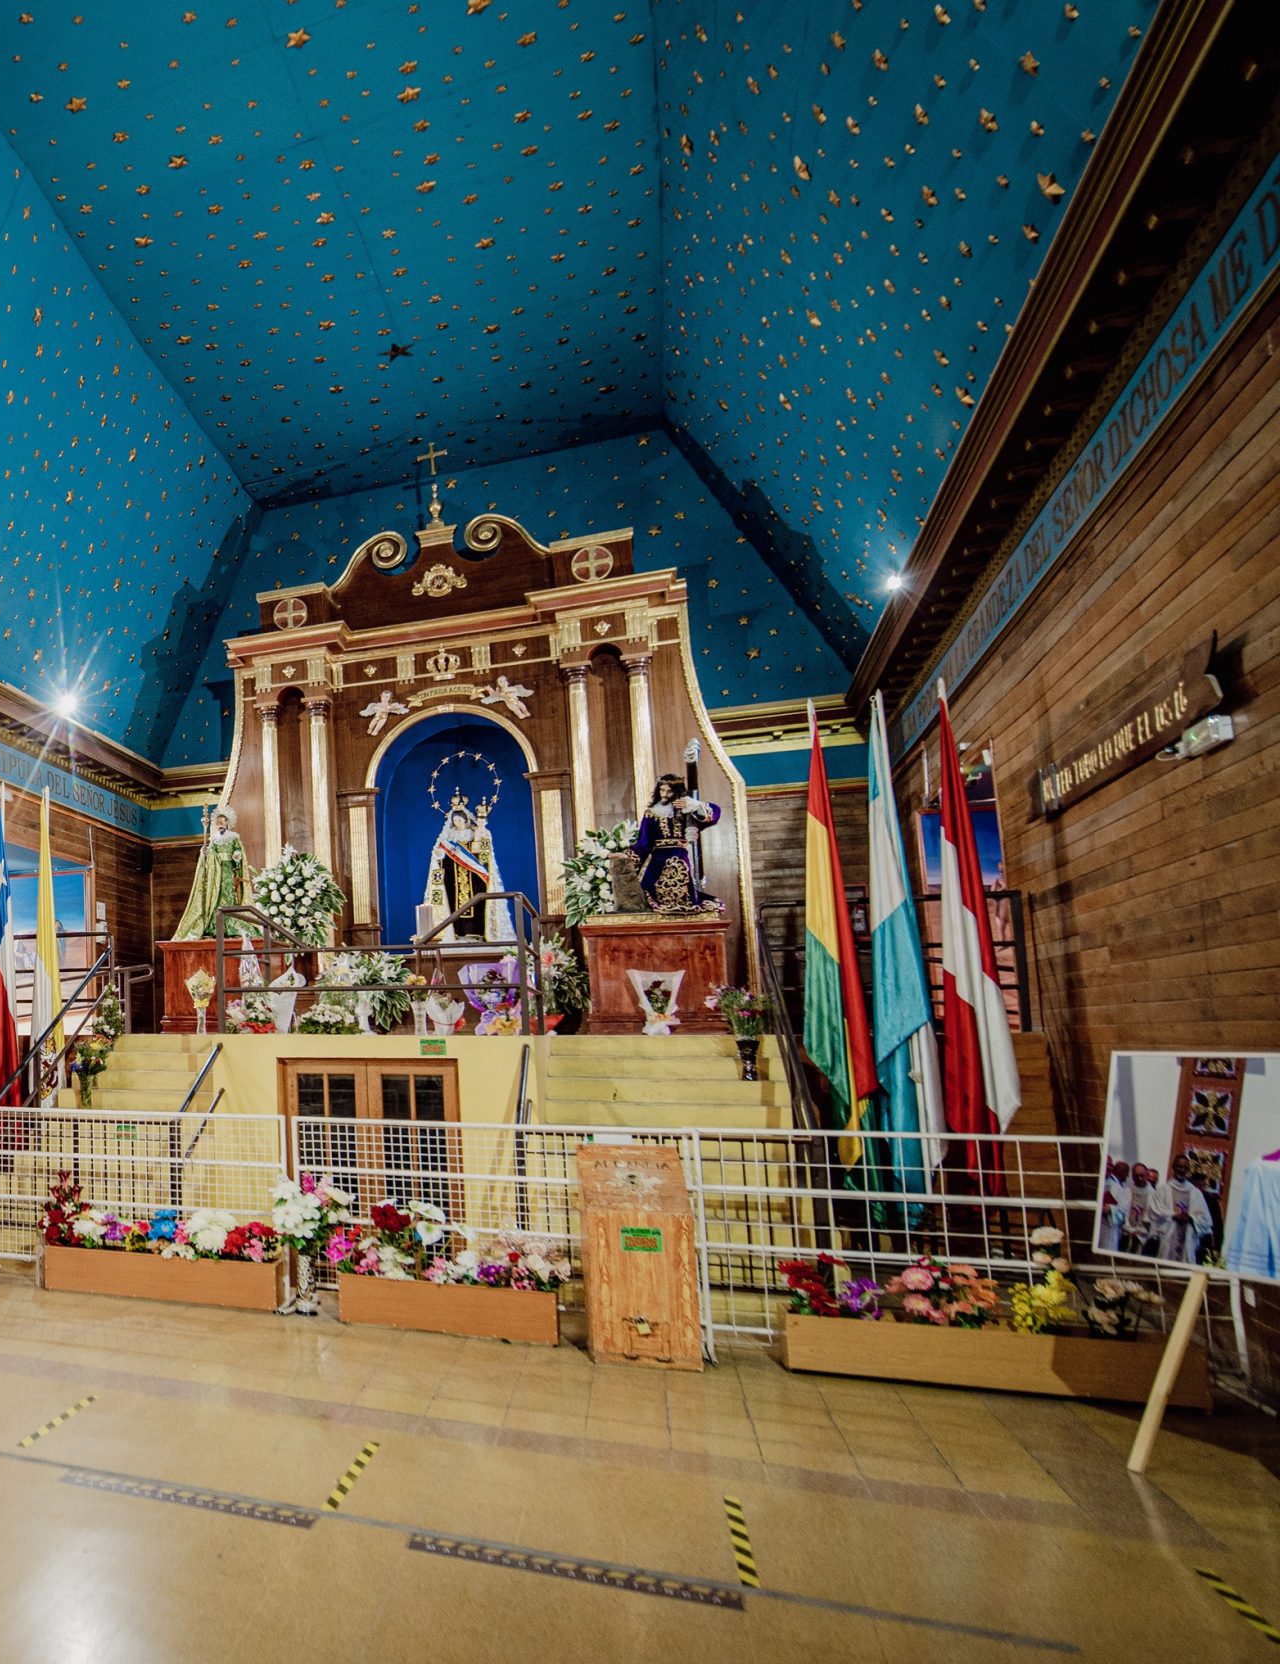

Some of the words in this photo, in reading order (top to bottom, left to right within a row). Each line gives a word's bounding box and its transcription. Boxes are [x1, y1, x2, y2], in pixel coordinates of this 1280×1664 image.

[967, 560, 1025, 660] GRANDEZA
[1024, 523, 1052, 584] DEL
[1052, 445, 1108, 543] SEÑOR
[1108, 302, 1208, 472] DICHOSA
[1207, 231, 1254, 333] ME
[46, 770, 70, 799] DEL
[72, 781, 106, 814] SEÑOR
[108, 798, 138, 826] JESUS
